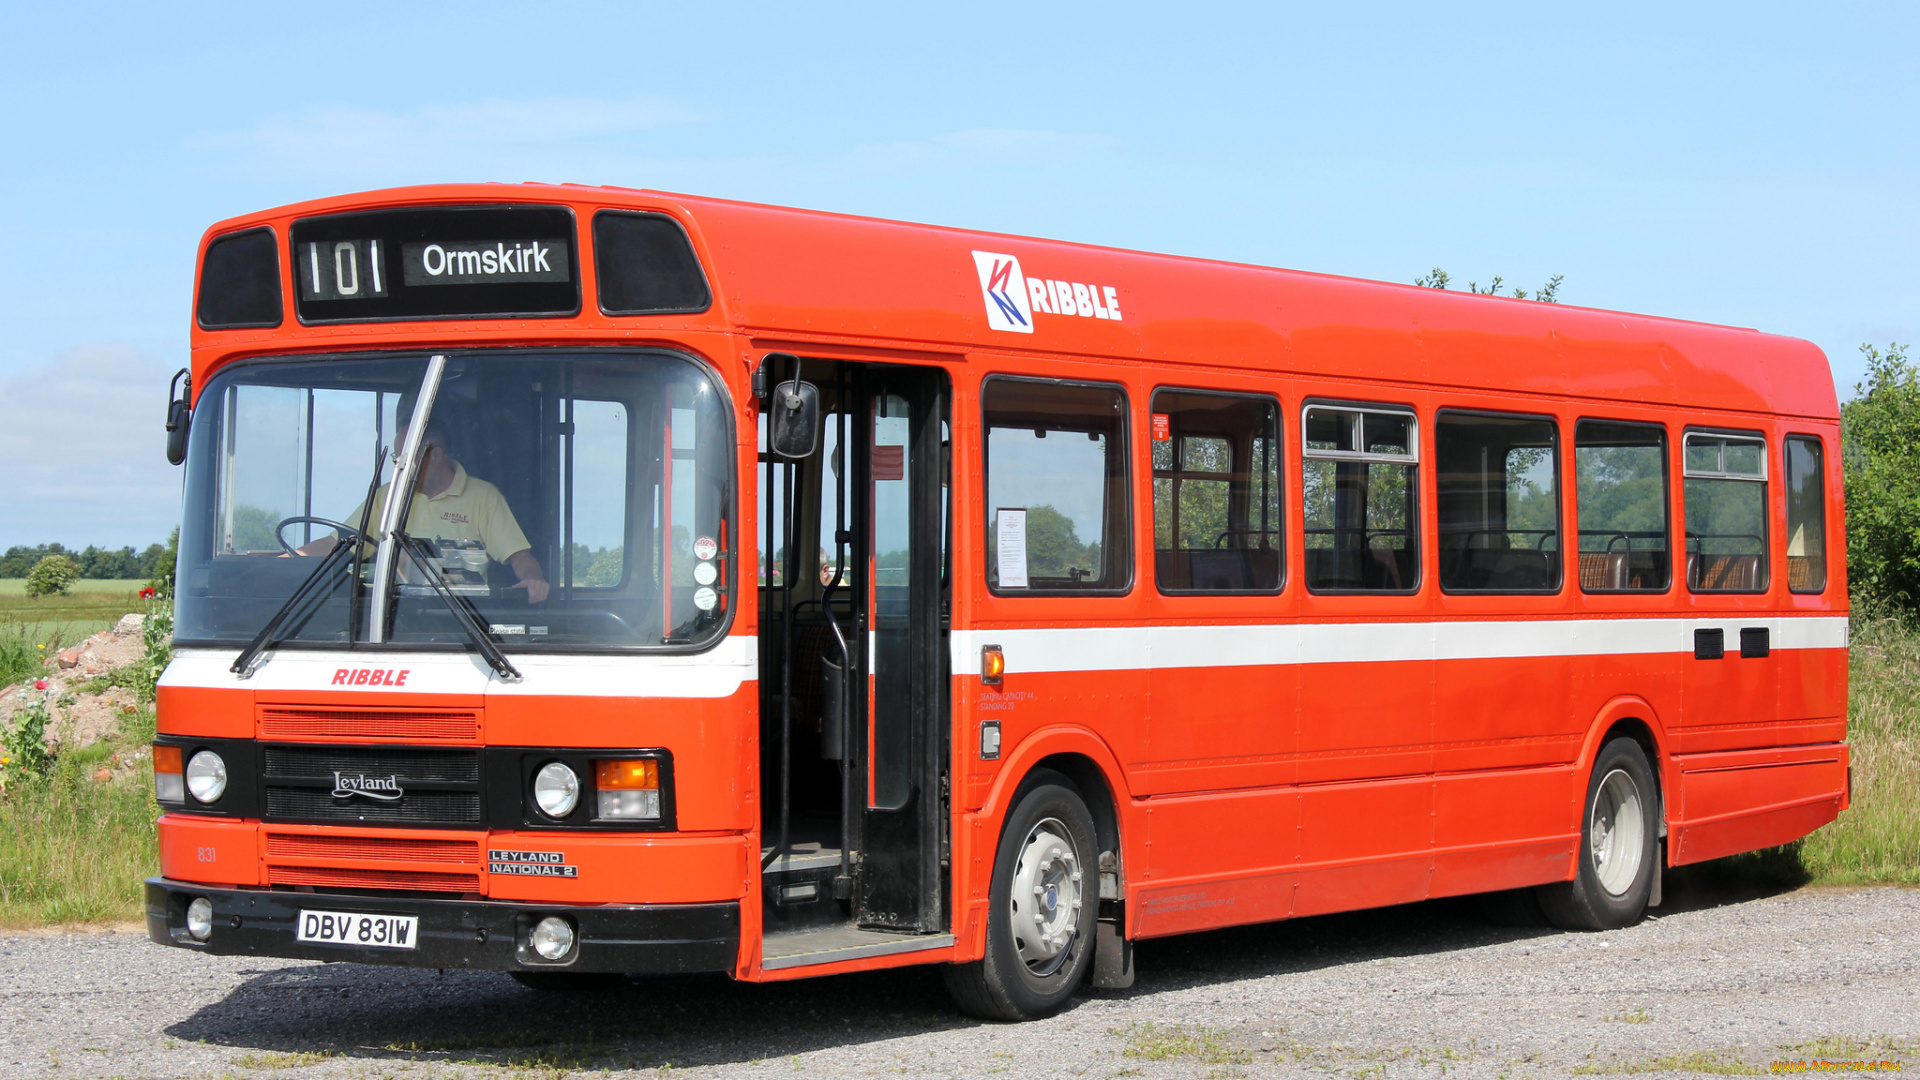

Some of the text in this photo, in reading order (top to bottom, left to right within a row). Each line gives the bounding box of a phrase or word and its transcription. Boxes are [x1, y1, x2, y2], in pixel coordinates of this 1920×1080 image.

[310, 239, 551, 295] 101 Ormskirk
[1026, 277, 1123, 321] RIBBLE
[331, 668, 411, 687] RIBBLE
[331, 771, 404, 800] Leyland
[198, 847, 216, 862] 831
[492, 851, 560, 862] LEYLAND
[492, 864, 573, 876] NATIONAL 2
[305, 914, 410, 944] DBV 831W
